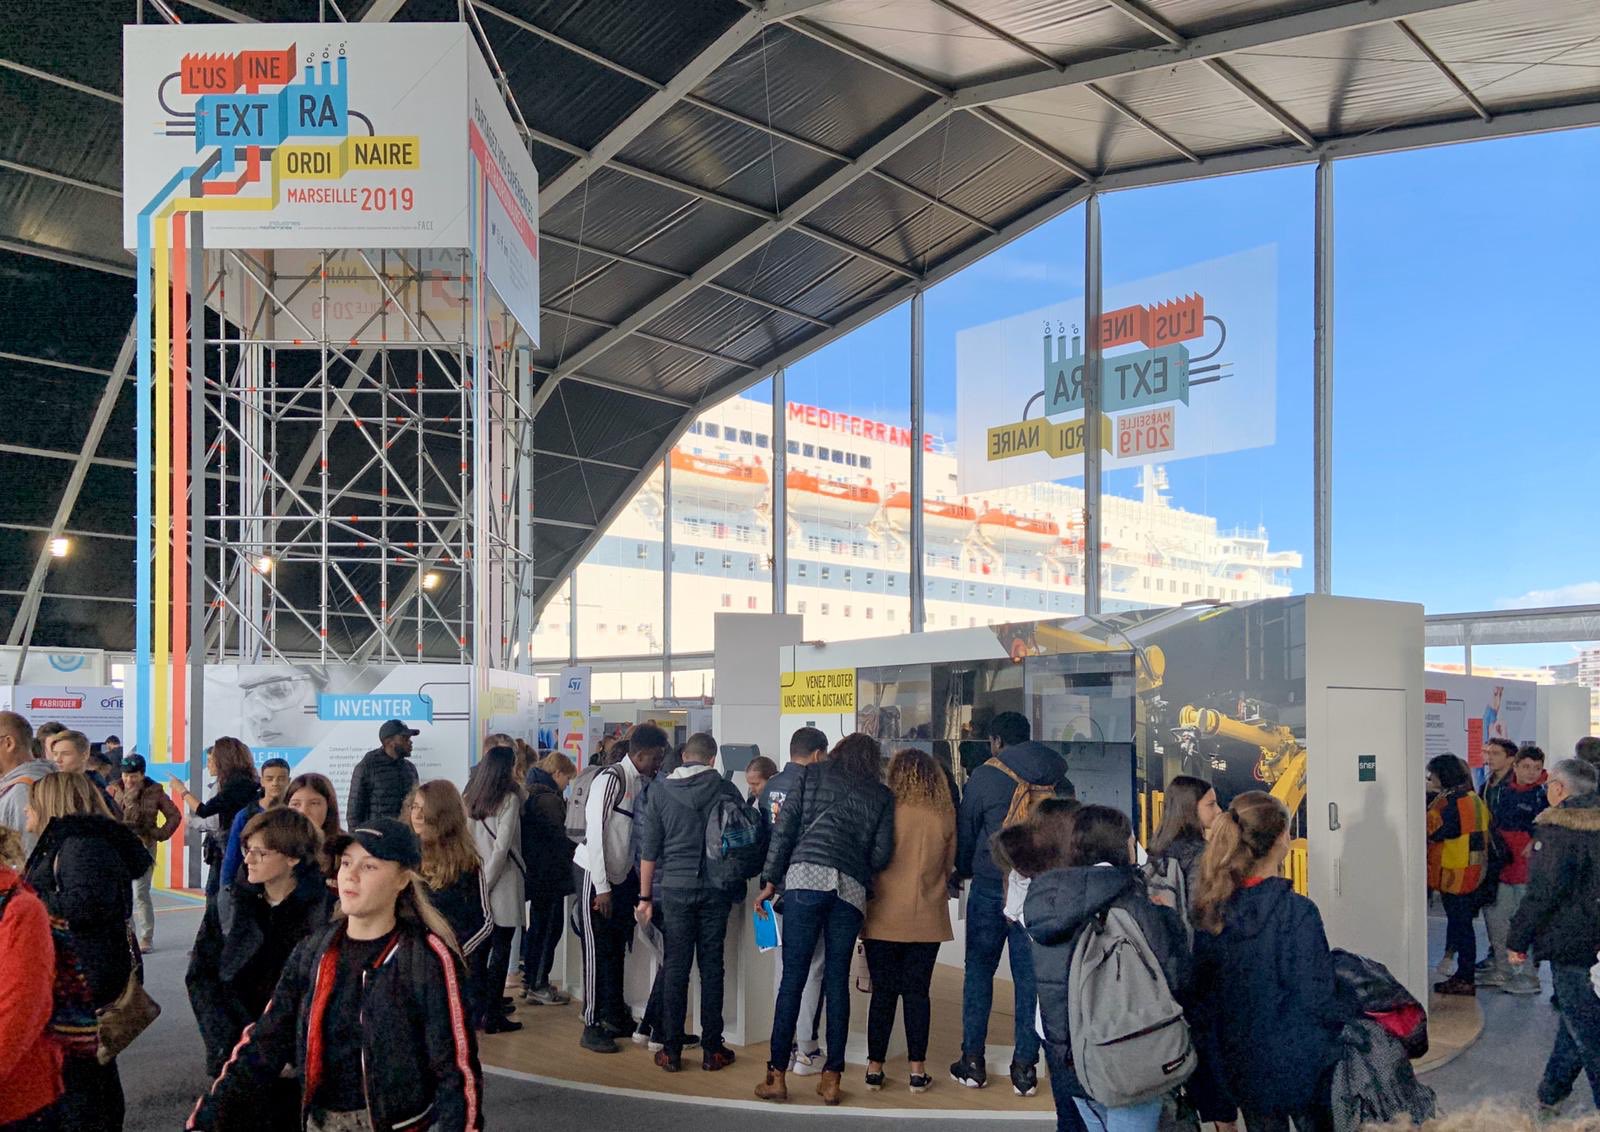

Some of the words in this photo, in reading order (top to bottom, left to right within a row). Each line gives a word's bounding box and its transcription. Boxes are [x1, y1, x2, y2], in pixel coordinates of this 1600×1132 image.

[189, 67, 226, 89] L'US
[249, 57, 280, 79] INE
[216, 104, 268, 136] EXT
[300, 95, 338, 127] RA
[287, 152, 331, 174] ORDI
[355, 143, 413, 165] NAIRE
[288, 188, 357, 203] MARSEILLE
[361, 187, 413, 211] 2019
[787, 401, 933, 452] MEDITERRANE
[806, 675, 826, 688] VENEZ
[827, 673, 853, 687] PILOTER
[39, 699, 77, 708] FABRIQUER
[334, 699, 411, 717] INVENTER
[784, 695, 796, 708] UNE
[797, 694, 815, 707] USINE
[822, 693, 853, 706] DISTANCE
